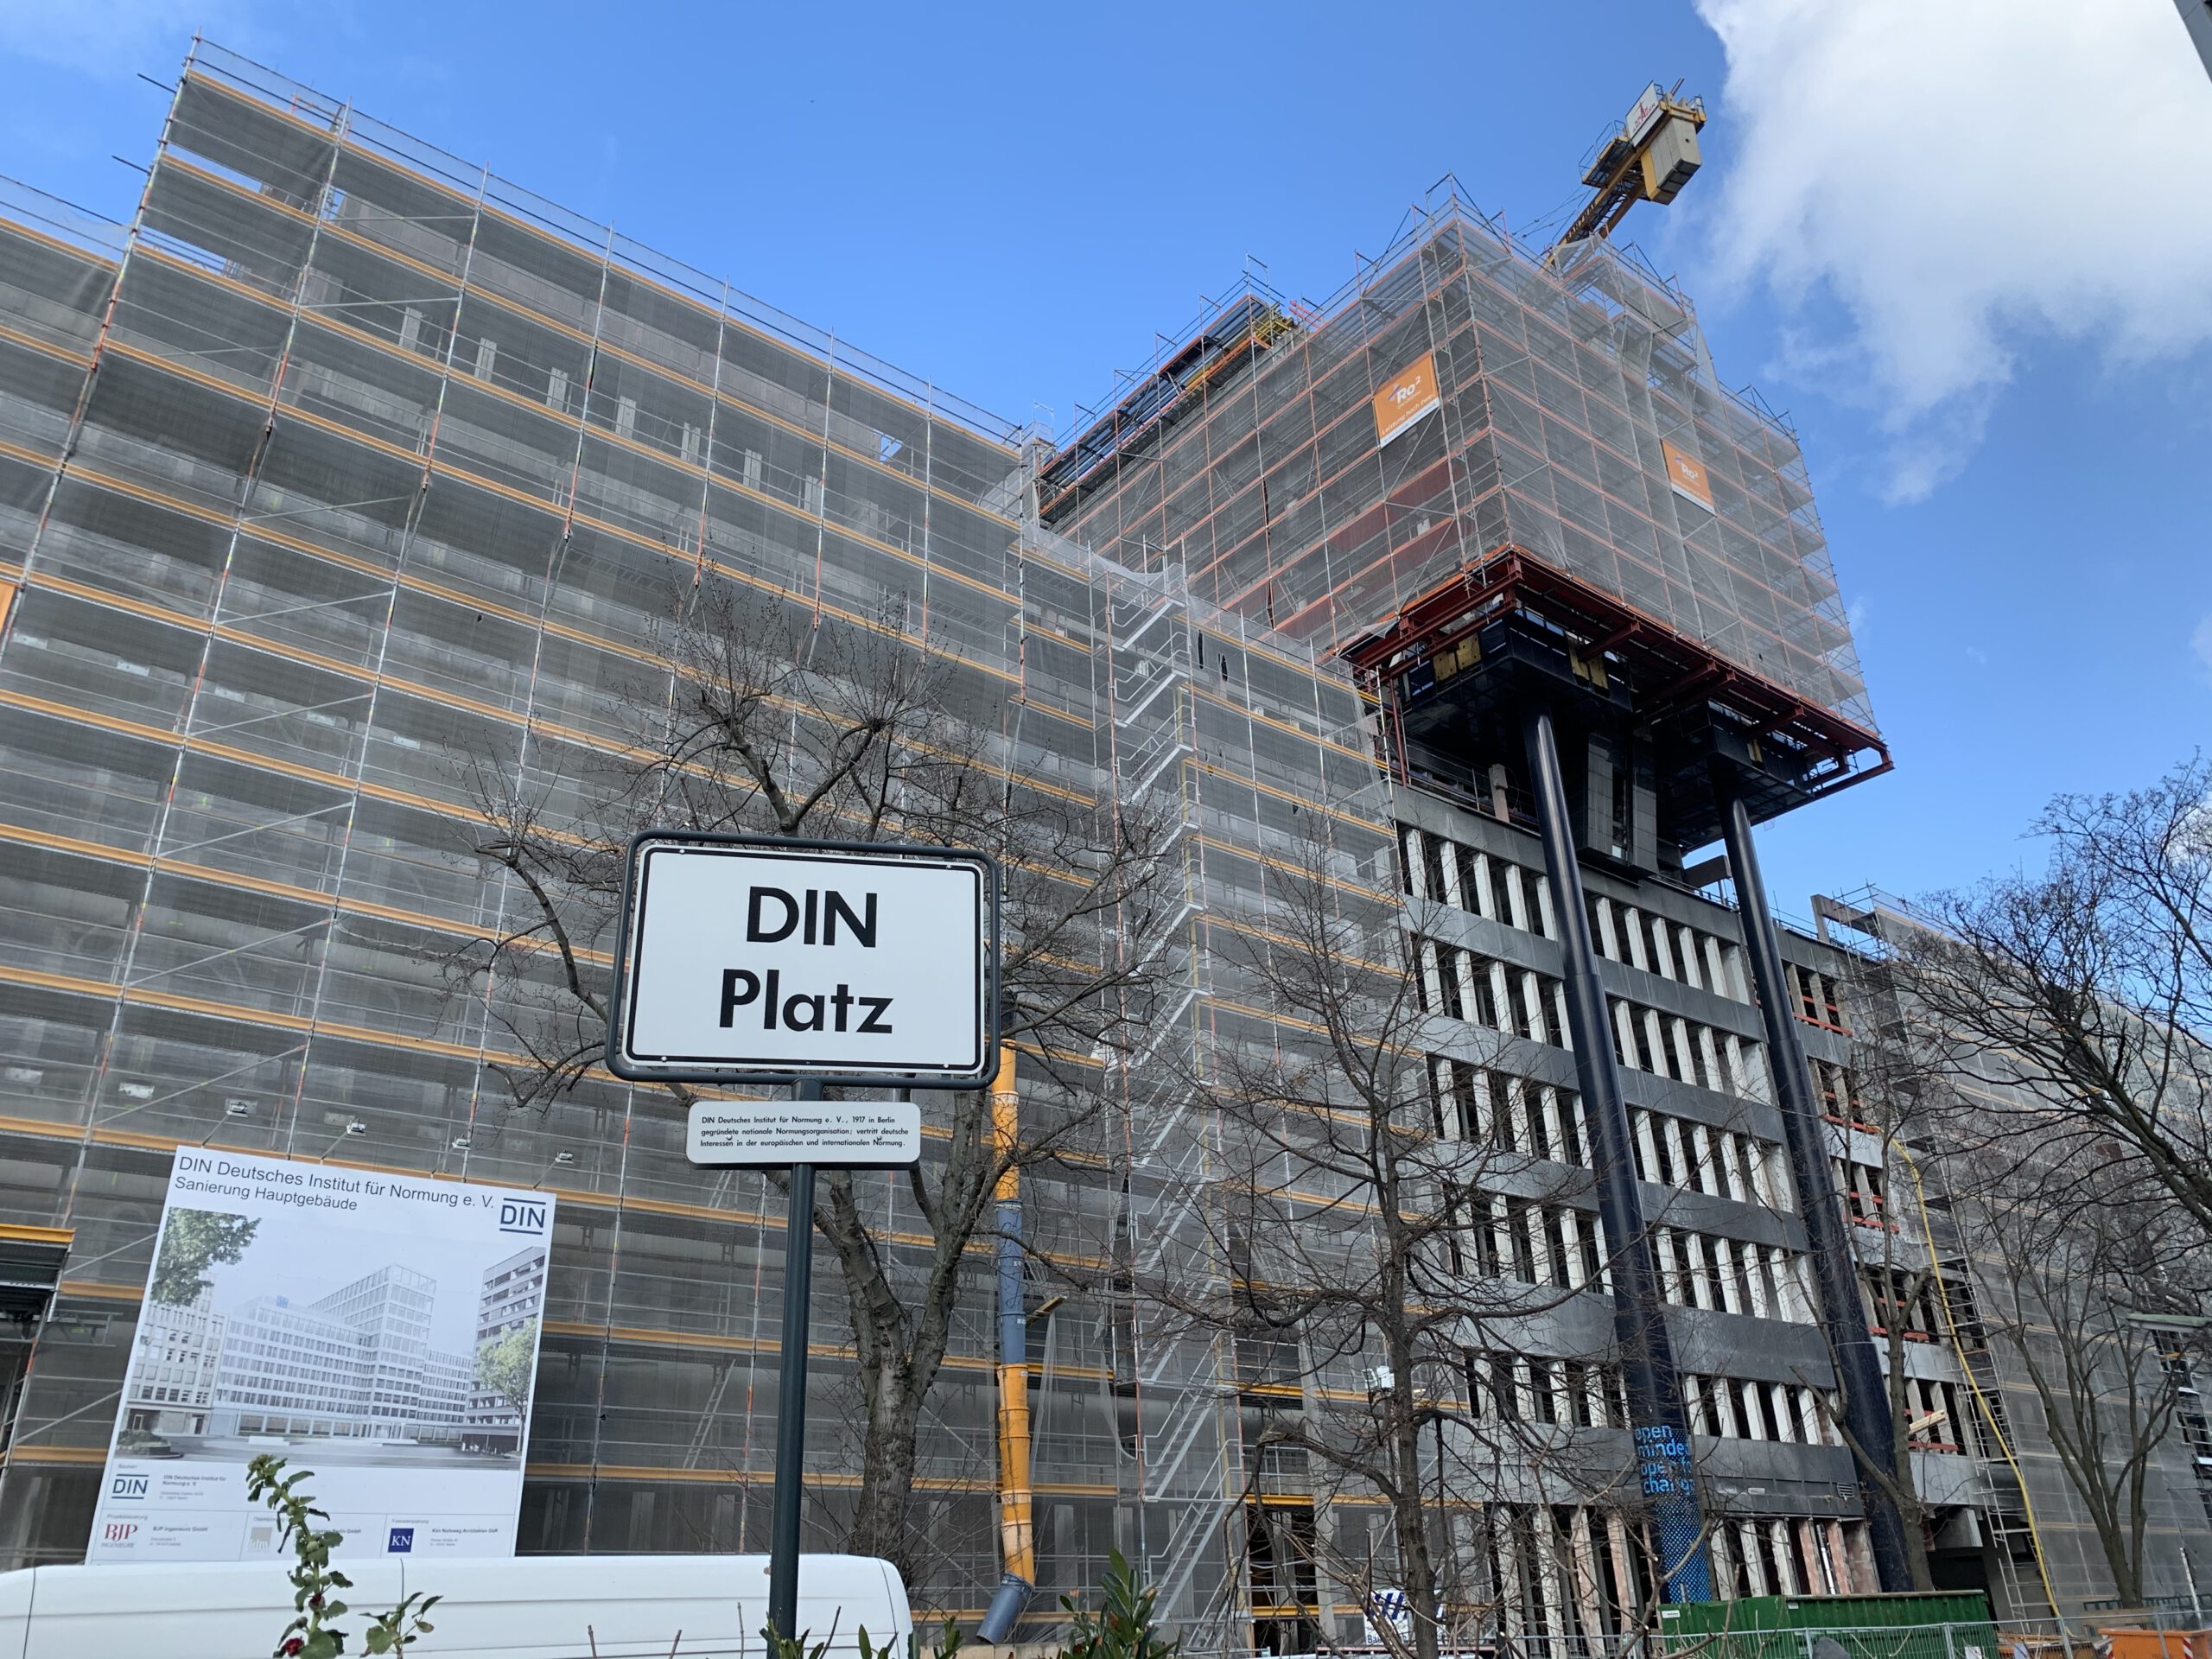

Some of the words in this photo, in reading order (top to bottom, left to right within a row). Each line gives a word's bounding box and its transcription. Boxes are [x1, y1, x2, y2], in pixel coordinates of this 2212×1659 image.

[747, 886, 878, 948] DIN
[719, 969, 893, 1034] Platz
[791, 1116, 823, 1124] Normung
[701, 1128, 739, 1136] gegründete
[775, 1127, 853, 1136] Normungsorganisation;
[760, 1139, 804, 1147] europäischen
[873, 1138, 906, 1147] Normung.
[179, 1156, 213, 1173] DIN
[217, 1161, 303, 1185] Deutsches
[308, 1173, 360, 1193] Institut
[365, 1180, 385, 1196] für
[390, 1184, 458, 1208] Normung
[462, 1196, 475, 1206] e.
[482, 1194, 494, 1209] V.
[175, 1176, 251, 1200] Sanierung
[255, 1186, 358, 1211] Hauptgebäude
[499, 1204, 546, 1229] DIN
[112, 1478, 149, 1495] DIN
[105, 1523, 138, 1542] BJP
[391, 1535, 411, 1547] KN
